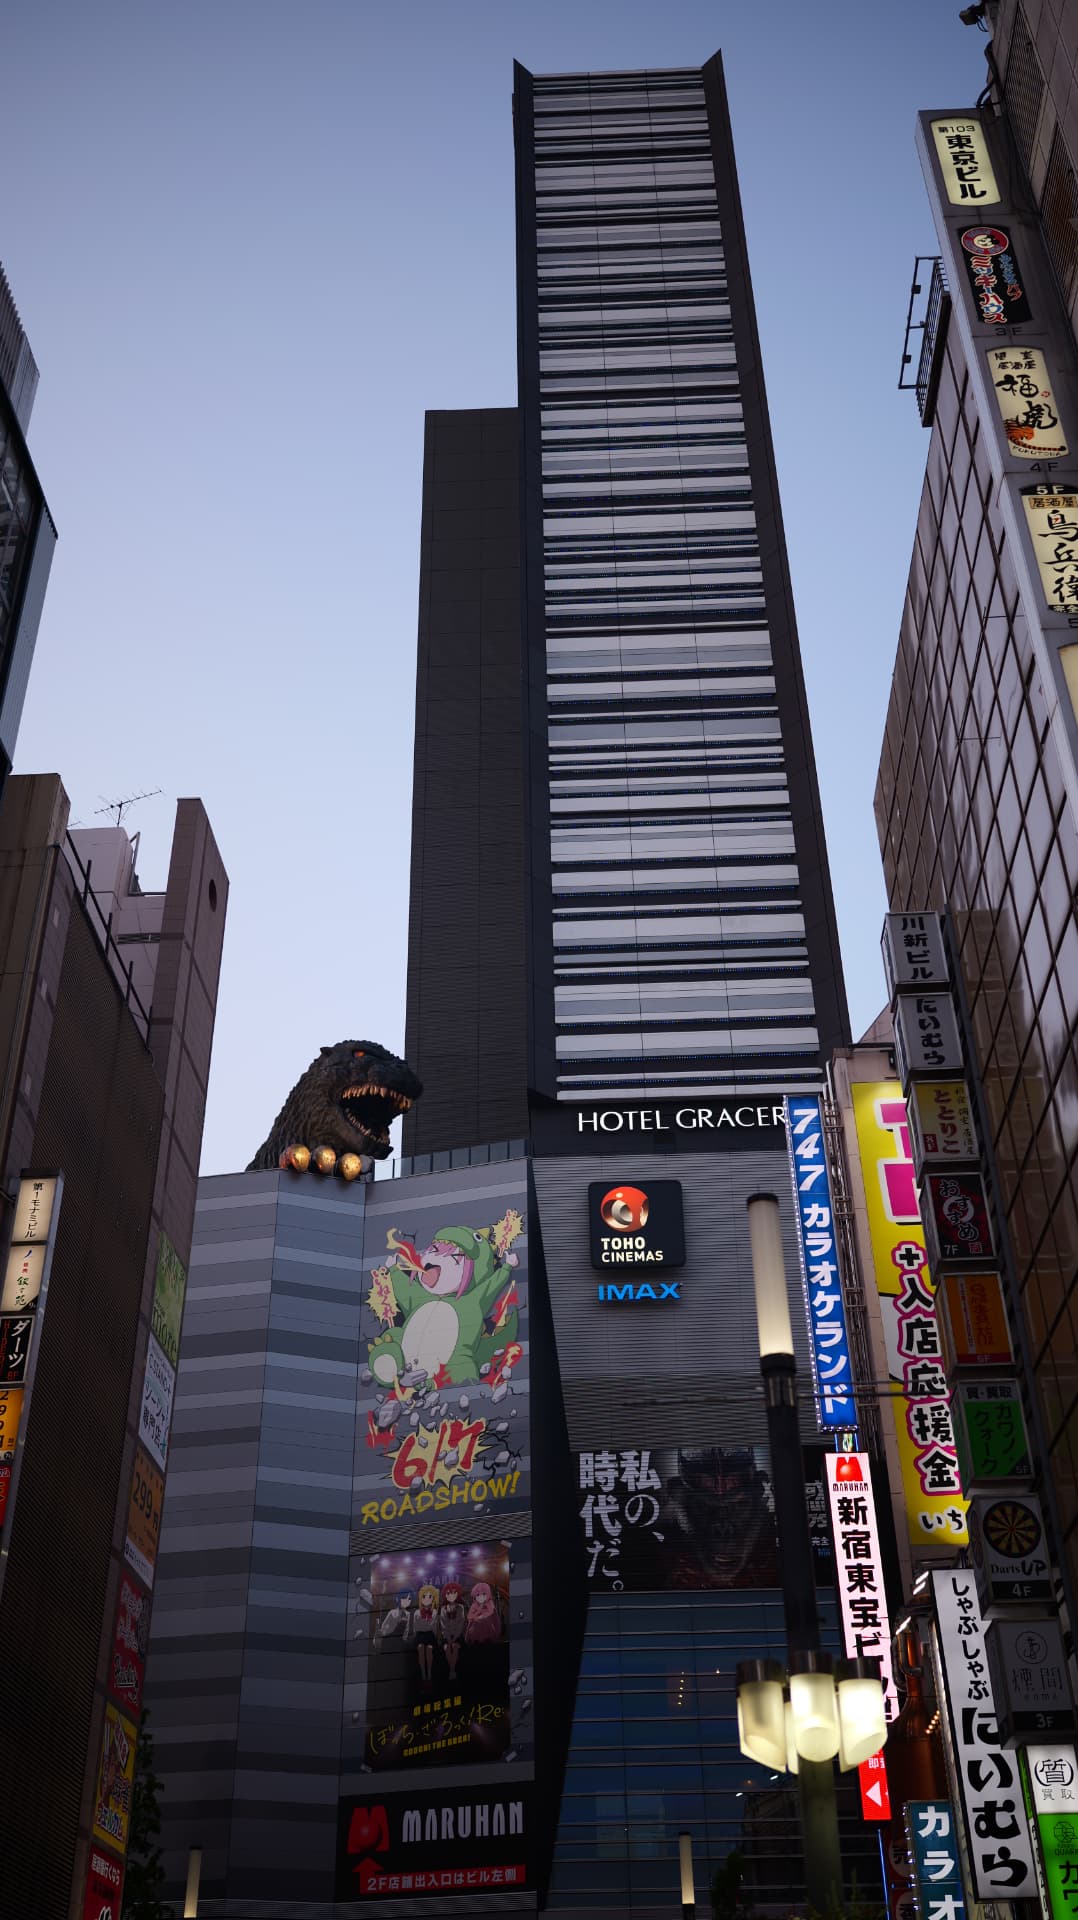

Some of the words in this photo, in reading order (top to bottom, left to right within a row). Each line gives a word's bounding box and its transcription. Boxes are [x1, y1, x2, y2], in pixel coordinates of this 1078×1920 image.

[945, 134, 987, 199] 東京ビル
[970, 256, 1008, 324] ミッキーハウス
[995, 326, 1023, 336] 3F
[1030, 462, 1059, 472] 4F
[1032, 496, 1077, 508] 居酒屋
[1036, 485, 1065, 495] 5F
[901, 916, 934, 980] 川新ビル
[916, 998, 946, 1066] にいむら
[577, 1108, 670, 1132] HOTEL
[600, 1237, 646, 1250] TOHO
[944, 1244, 959, 1256] 7F
[600, 1249, 664, 1263] CINEMAS
[598, 1282, 682, 1301] IMAX
[8, 1319, 31, 1369] ダーツ
[392, 1419, 486, 1489] 6/7
[361, 1471, 521, 1525] ROADSHOW!
[620, 1450, 665, 1542] 私の、
[832, 1482, 869, 1492] MARUHAN
[579, 1450, 624, 1591] 時代だ。
[990, 1562, 1020, 1575] Darts
[1021, 1559, 1047, 1576] UP
[1012, 1583, 1033, 1597] 4F
[951, 1577, 991, 1701] しゃぶしゃぶ
[1035, 1713, 1056, 1728] 3F
[961, 1707, 1029, 1888] にいむら
[1042, 1789, 1076, 1801] 買取
[402, 1802, 524, 1843] MARUHAN
[367, 1865, 517, 1892] 2F店舗出入口はビル左側
